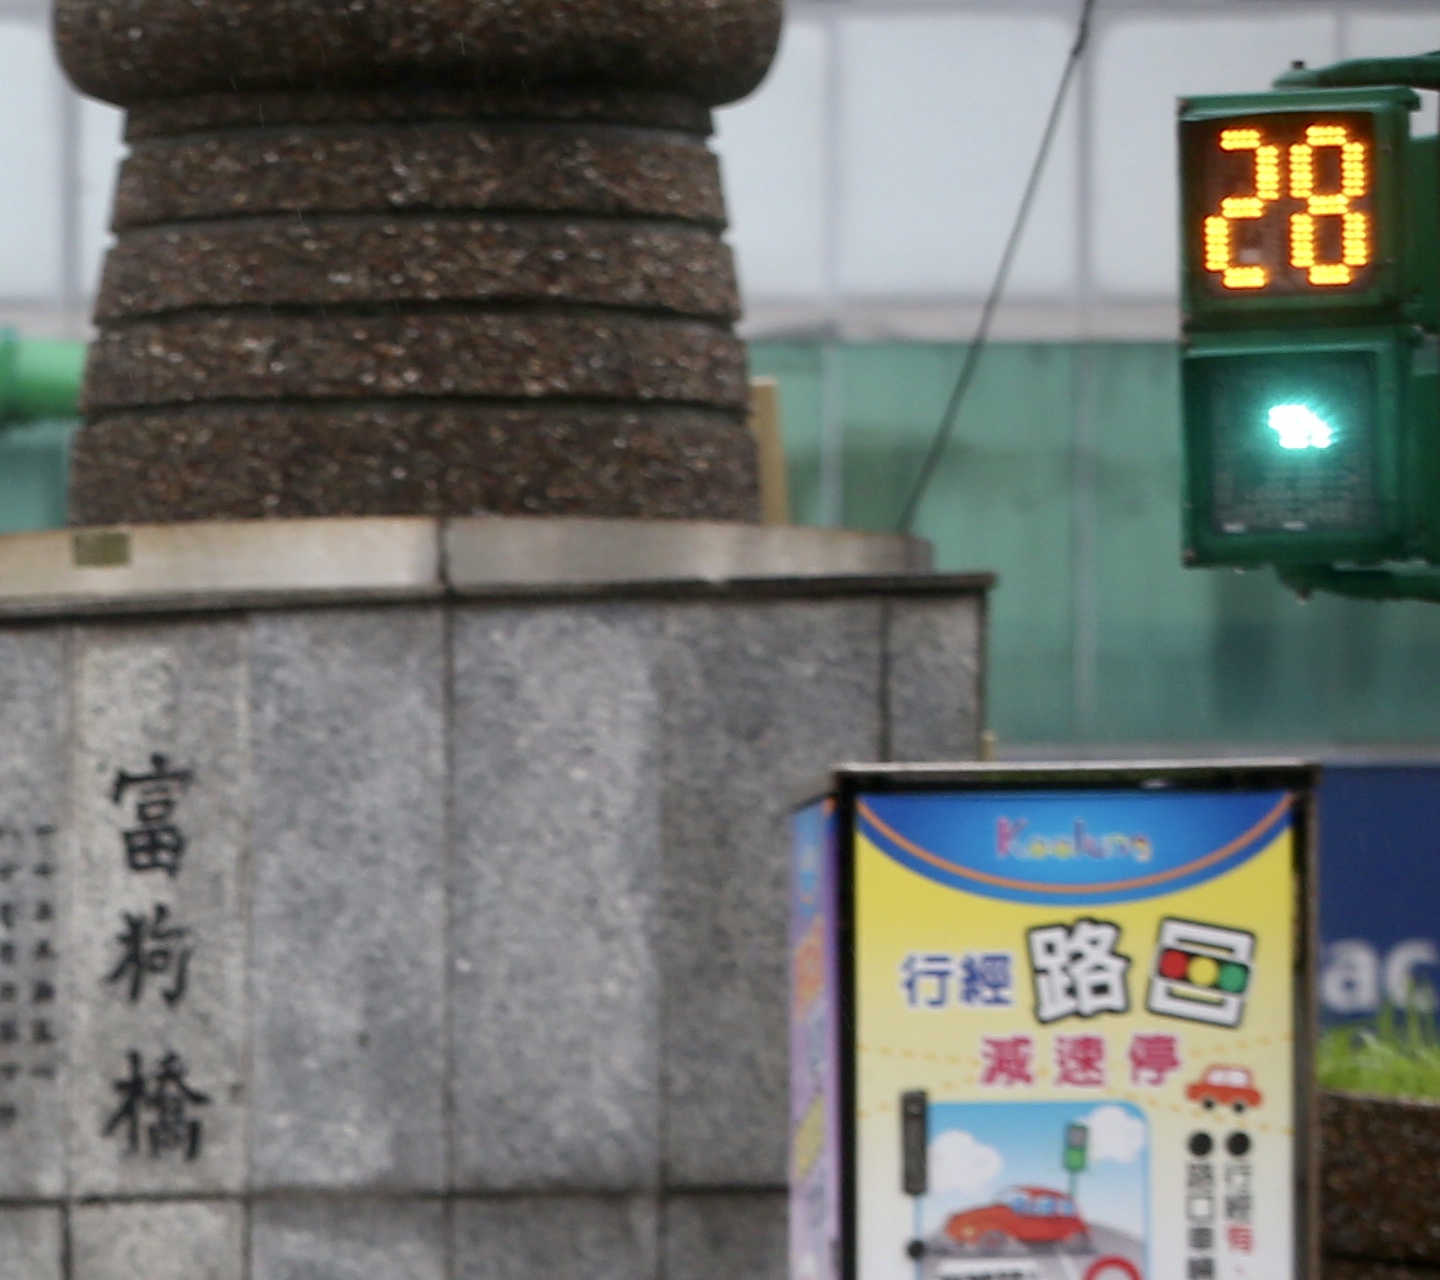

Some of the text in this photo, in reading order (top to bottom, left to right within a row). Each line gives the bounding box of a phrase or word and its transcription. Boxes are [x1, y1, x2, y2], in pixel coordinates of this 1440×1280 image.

[1203, 124, 1368, 289] 28
[979, 1034, 1184, 1089] 減速停
